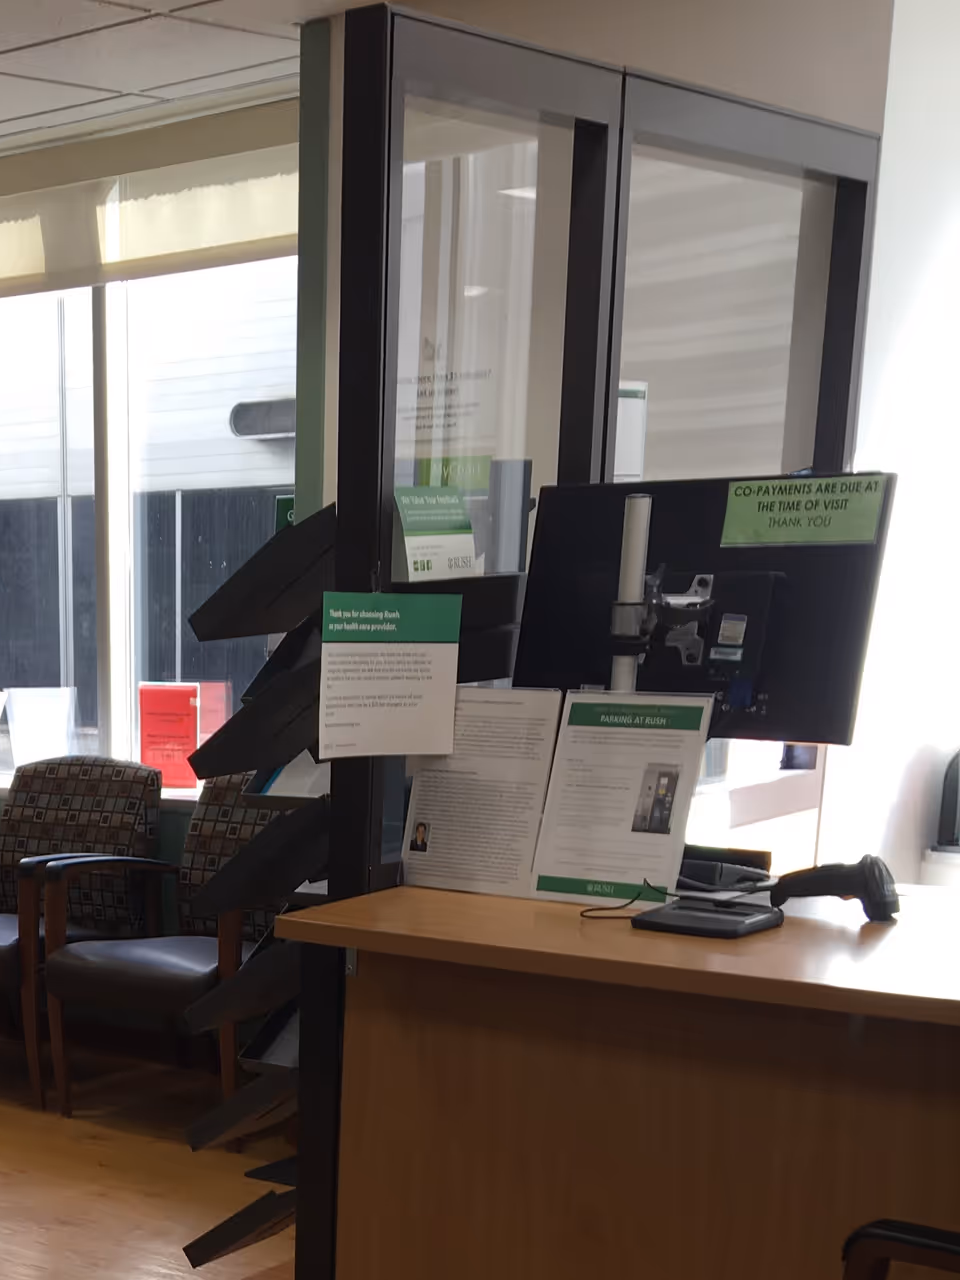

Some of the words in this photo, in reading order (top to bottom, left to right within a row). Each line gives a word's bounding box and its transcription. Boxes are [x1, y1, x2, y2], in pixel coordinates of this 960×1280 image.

[734, 483, 812, 498] CO-PAYMENTS
[815, 482, 837, 495] ARE
[840, 481, 862, 494] DUE
[864, 480, 880, 492] AT
[757, 501, 775, 513] THE
[777, 500, 801, 512] TIME
[804, 499, 819, 511] OF
[823, 498, 849, 511] VISIT
[768, 516, 802, 529] THANK
[807, 516, 832, 528] YOU
[453, 556, 472, 570] RUSH
[329, 608, 342, 618] Thank
[342, 610, 351, 619] you
[351, 608, 359, 618] for
[359, 608, 383, 620] choosing
[383, 609, 400, 619] Rush
[333, 623, 344, 632] your
[343, 621, 359, 630] health
[370, 621, 397, 632] provider.
[600, 714, 633, 725] PARKING
[633, 715, 645, 725] AT
[644, 716, 667, 726] RUSH
